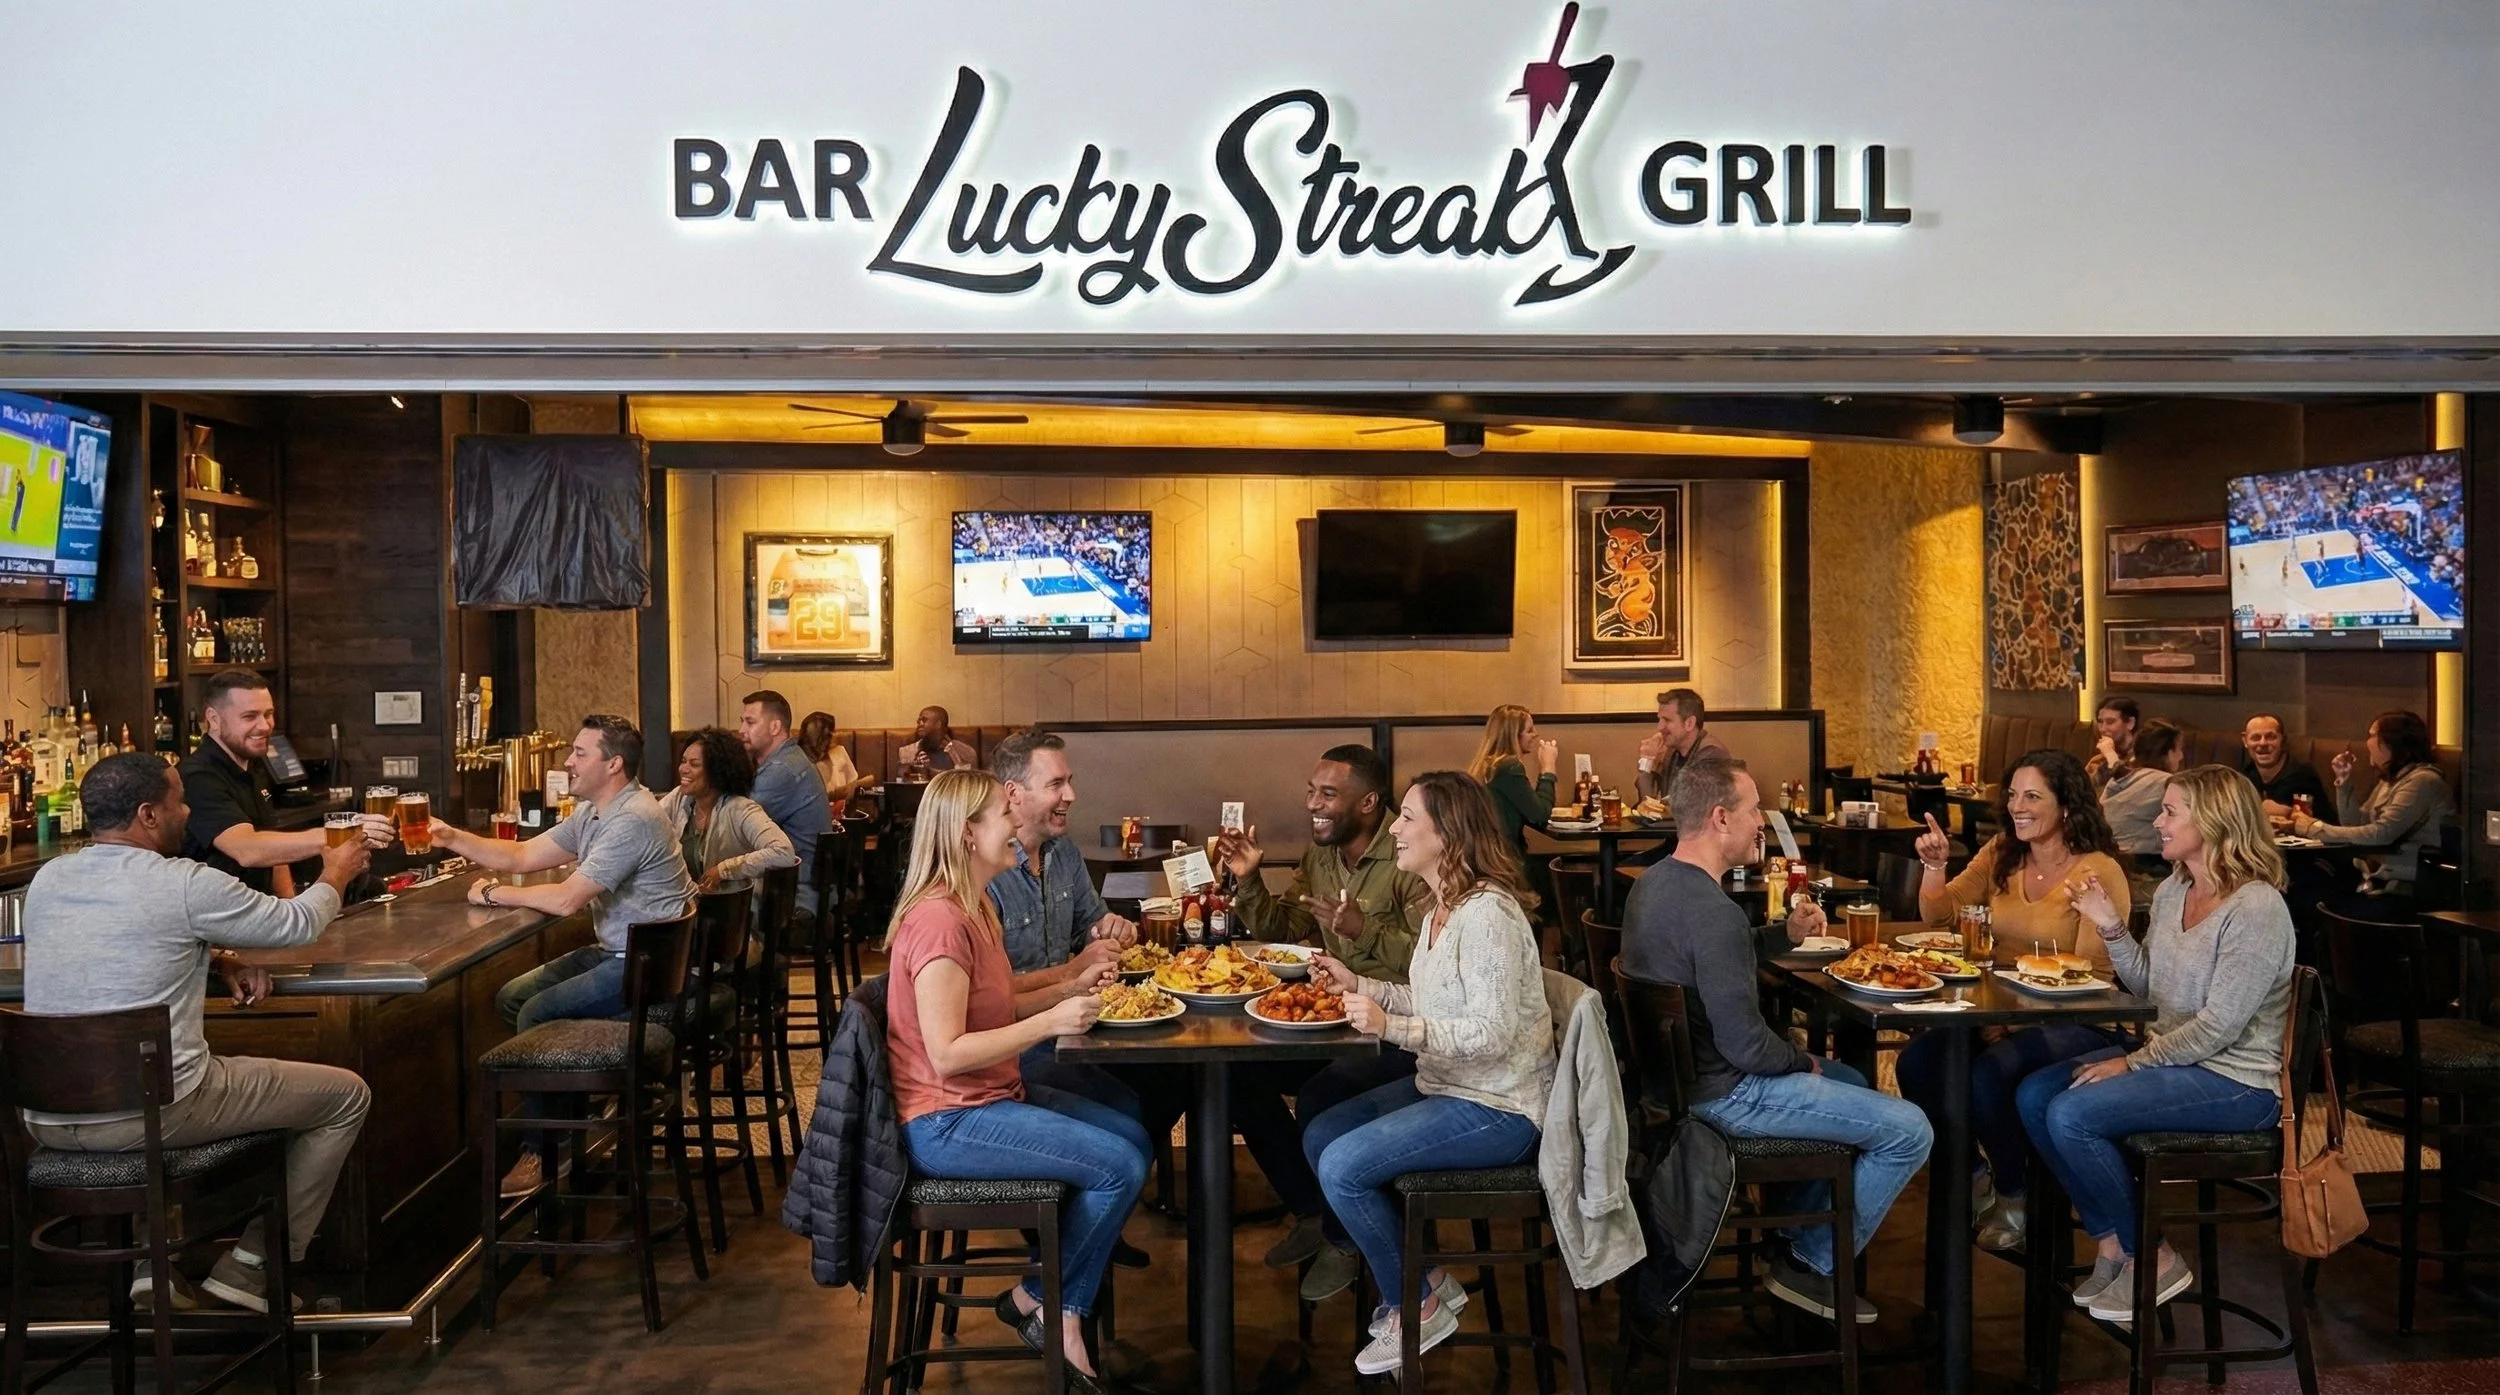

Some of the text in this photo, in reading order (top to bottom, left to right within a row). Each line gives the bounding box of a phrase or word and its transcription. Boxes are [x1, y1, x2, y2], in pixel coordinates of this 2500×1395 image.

[674, 54, 1912, 306] BAR Lucky Streak GRILL
[795, 599, 843, 641] 29
